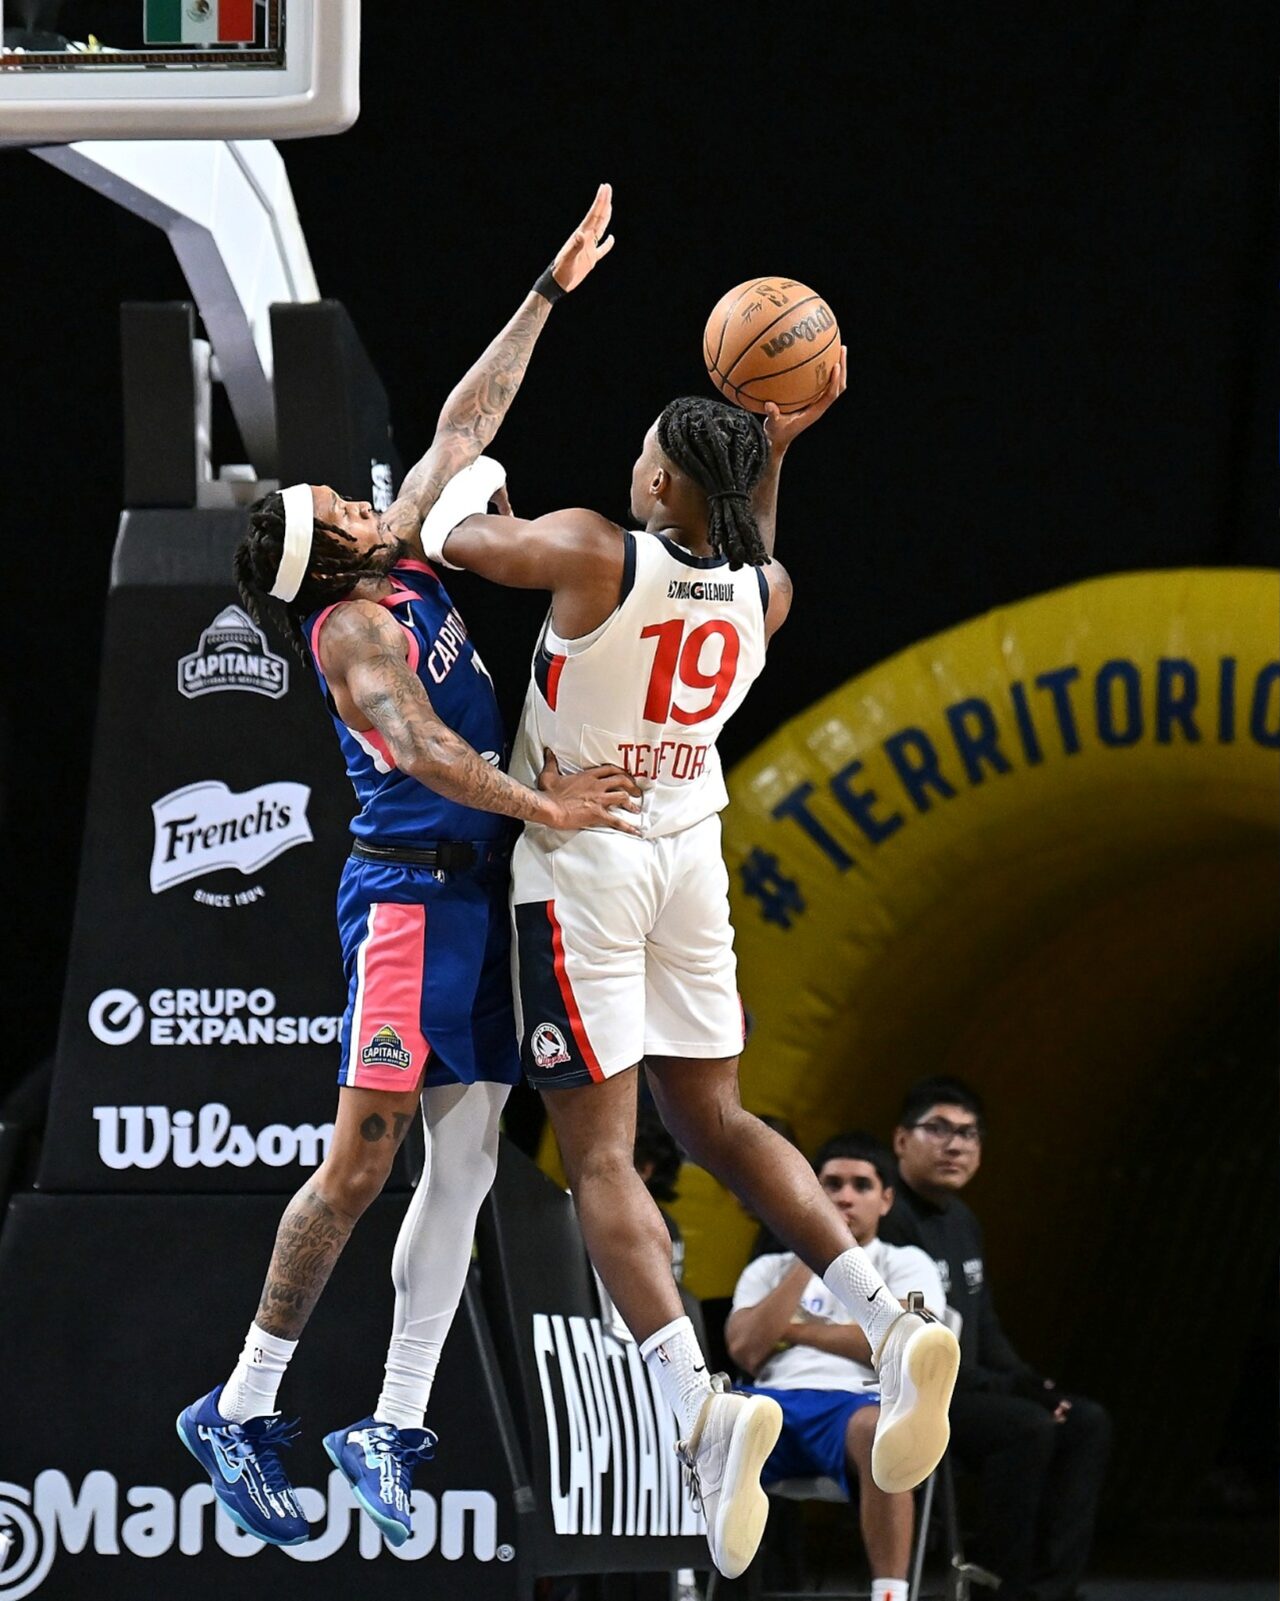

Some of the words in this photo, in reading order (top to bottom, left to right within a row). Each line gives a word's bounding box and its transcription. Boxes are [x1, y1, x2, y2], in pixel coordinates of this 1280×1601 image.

[760, 304, 835, 358] Wilson
[184, 653, 281, 682] CAPITANES
[640, 619, 740, 725] 19
[162, 800, 291, 863] French's
[193, 888, 232, 907] SINCE
[149, 988, 276, 1016] GRUPO
[363, 1047, 409, 1063] CAPITANES
[93, 1103, 336, 1169] Wilson
